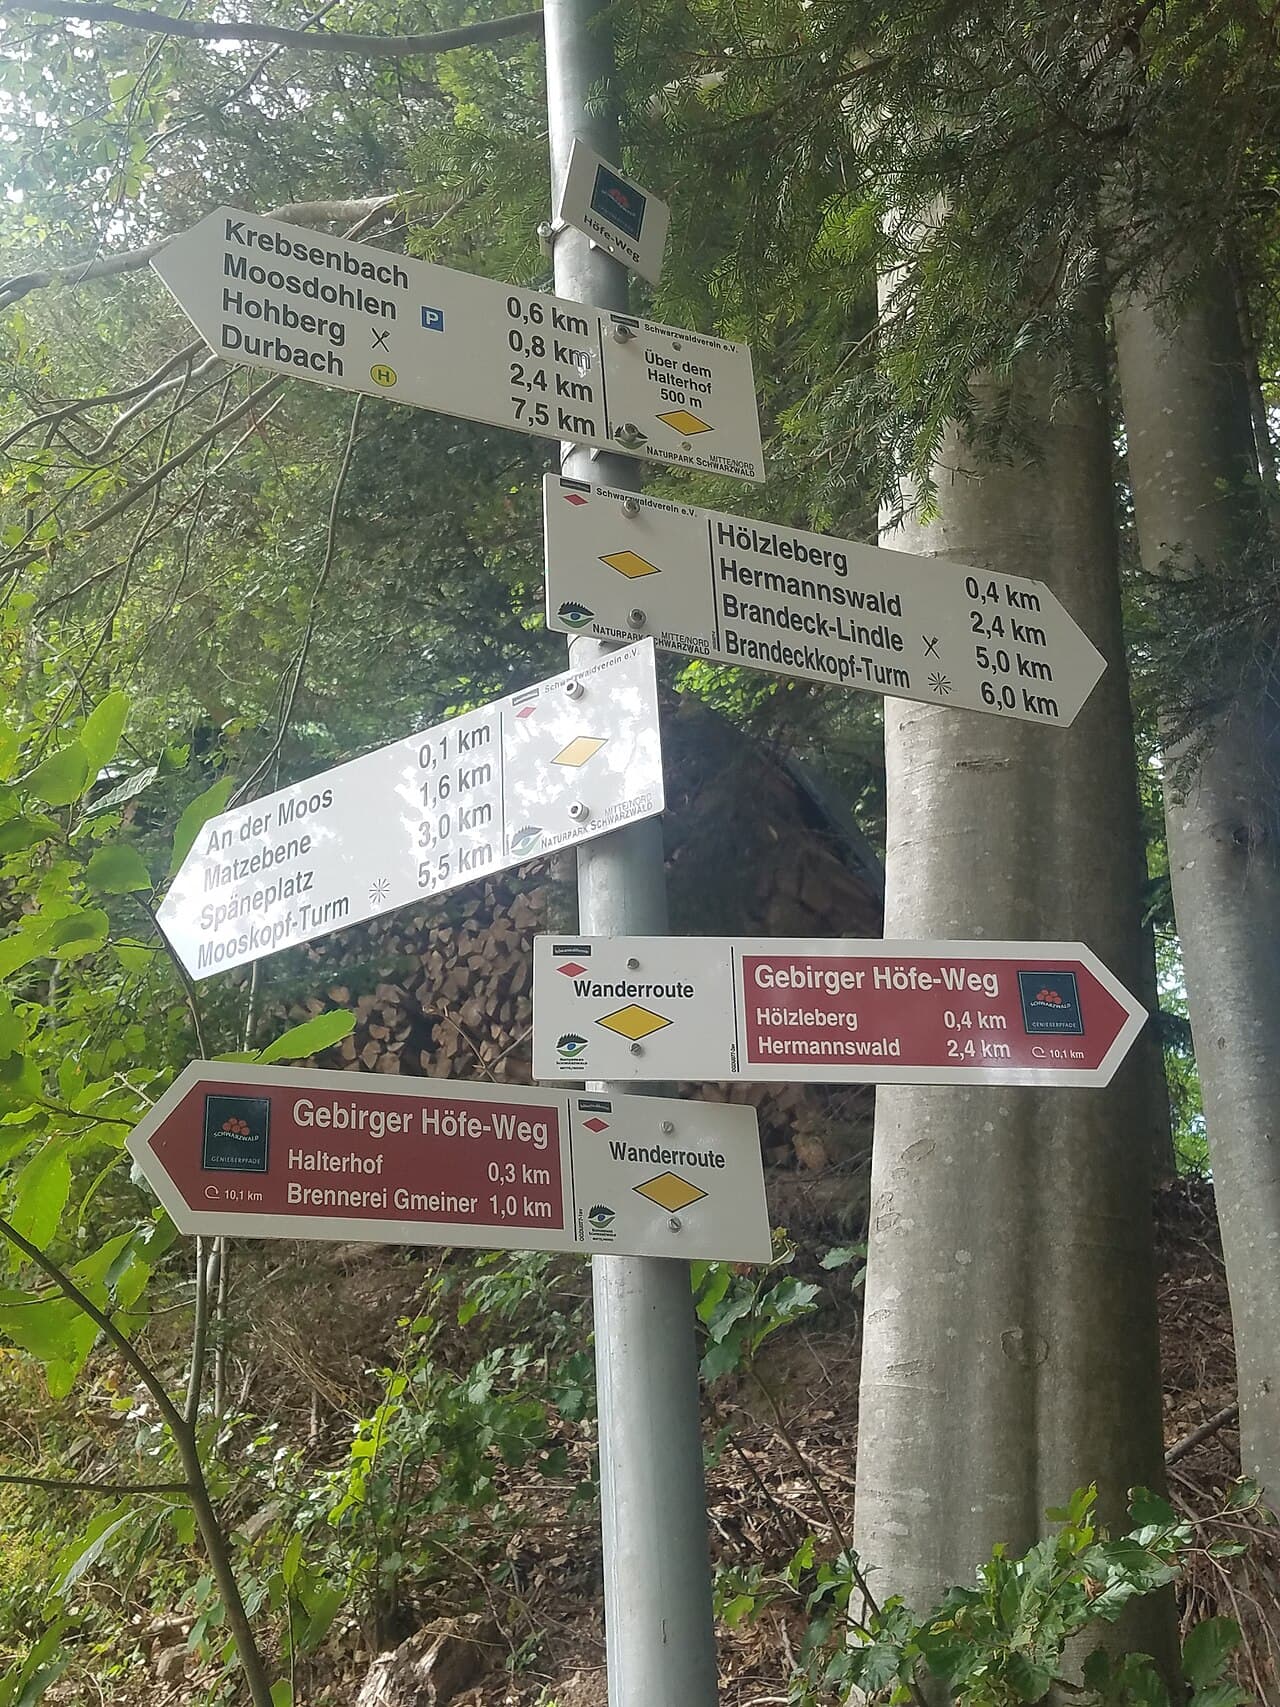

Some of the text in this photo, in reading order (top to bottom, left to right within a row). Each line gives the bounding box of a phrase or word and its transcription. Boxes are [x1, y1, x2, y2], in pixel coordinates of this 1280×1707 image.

[584, 215, 640, 263] Höfe-Weg
[225, 218, 409, 289] Krebsenbach
[507, 296, 544, 325] 0,6
[552, 307, 588, 336] km
[223, 253, 397, 320] Moosdohlen
[508, 329, 546, 358] 0,8
[554, 340, 591, 370] km
[222, 288, 592, 403] Hohberg 2,4 km
[644, 323, 739, 353] Schwarzwaldverein e.V.
[222, 324, 343, 376] Durbach
[511, 397, 549, 427] 7,5
[557, 407, 595, 437] km
[644, 349, 712, 378] Über dem
[647, 368, 712, 395] Halterhof
[660, 388, 702, 408] 500 m
[681, 505, 697, 517] e.V.
[718, 522, 1041, 612] Hölzleberg 0,4 km
[720, 557, 1046, 646] Hermannswald 2,4 km
[646, 635, 710, 656] CHWARZWALD
[723, 593, 904, 652] Brandeck-Lindle
[976, 646, 1010, 675] 5,0
[1017, 653, 1052, 682] km
[725, 629, 910, 689] Brandeckkopf-Turm
[981, 681, 1016, 711] 6,0
[1022, 688, 1058, 717] km
[205, 724, 490, 855] An der Moos 0,1 km
[203, 763, 491, 893] Matzebene 1,6 km
[201, 802, 492, 934] Späneplatz 3,0 km
[197, 896, 349, 969] Mooskopf-Turm
[418, 854, 450, 889] 5,5
[458, 843, 492, 873] km
[574, 980, 694, 998] Wanderroute
[754, 964, 1000, 998] Gebirger Höfe-Weg
[756, 1008, 1007, 1031] Hölzleberg 0,4 km
[758, 1036, 1010, 1059] Hermannswald 2,4 km
[1070, 1049, 1085, 1059] km
[293, 1099, 548, 1149] Gebirger Höfe-Weg
[288, 1149, 550, 1185] Halterhof 0,3 km
[609, 1141, 725, 1168] Wanderroute
[248, 1190, 263, 1200] km
[287, 1183, 551, 1218] Brennerei Gmeiner 1,0 km
